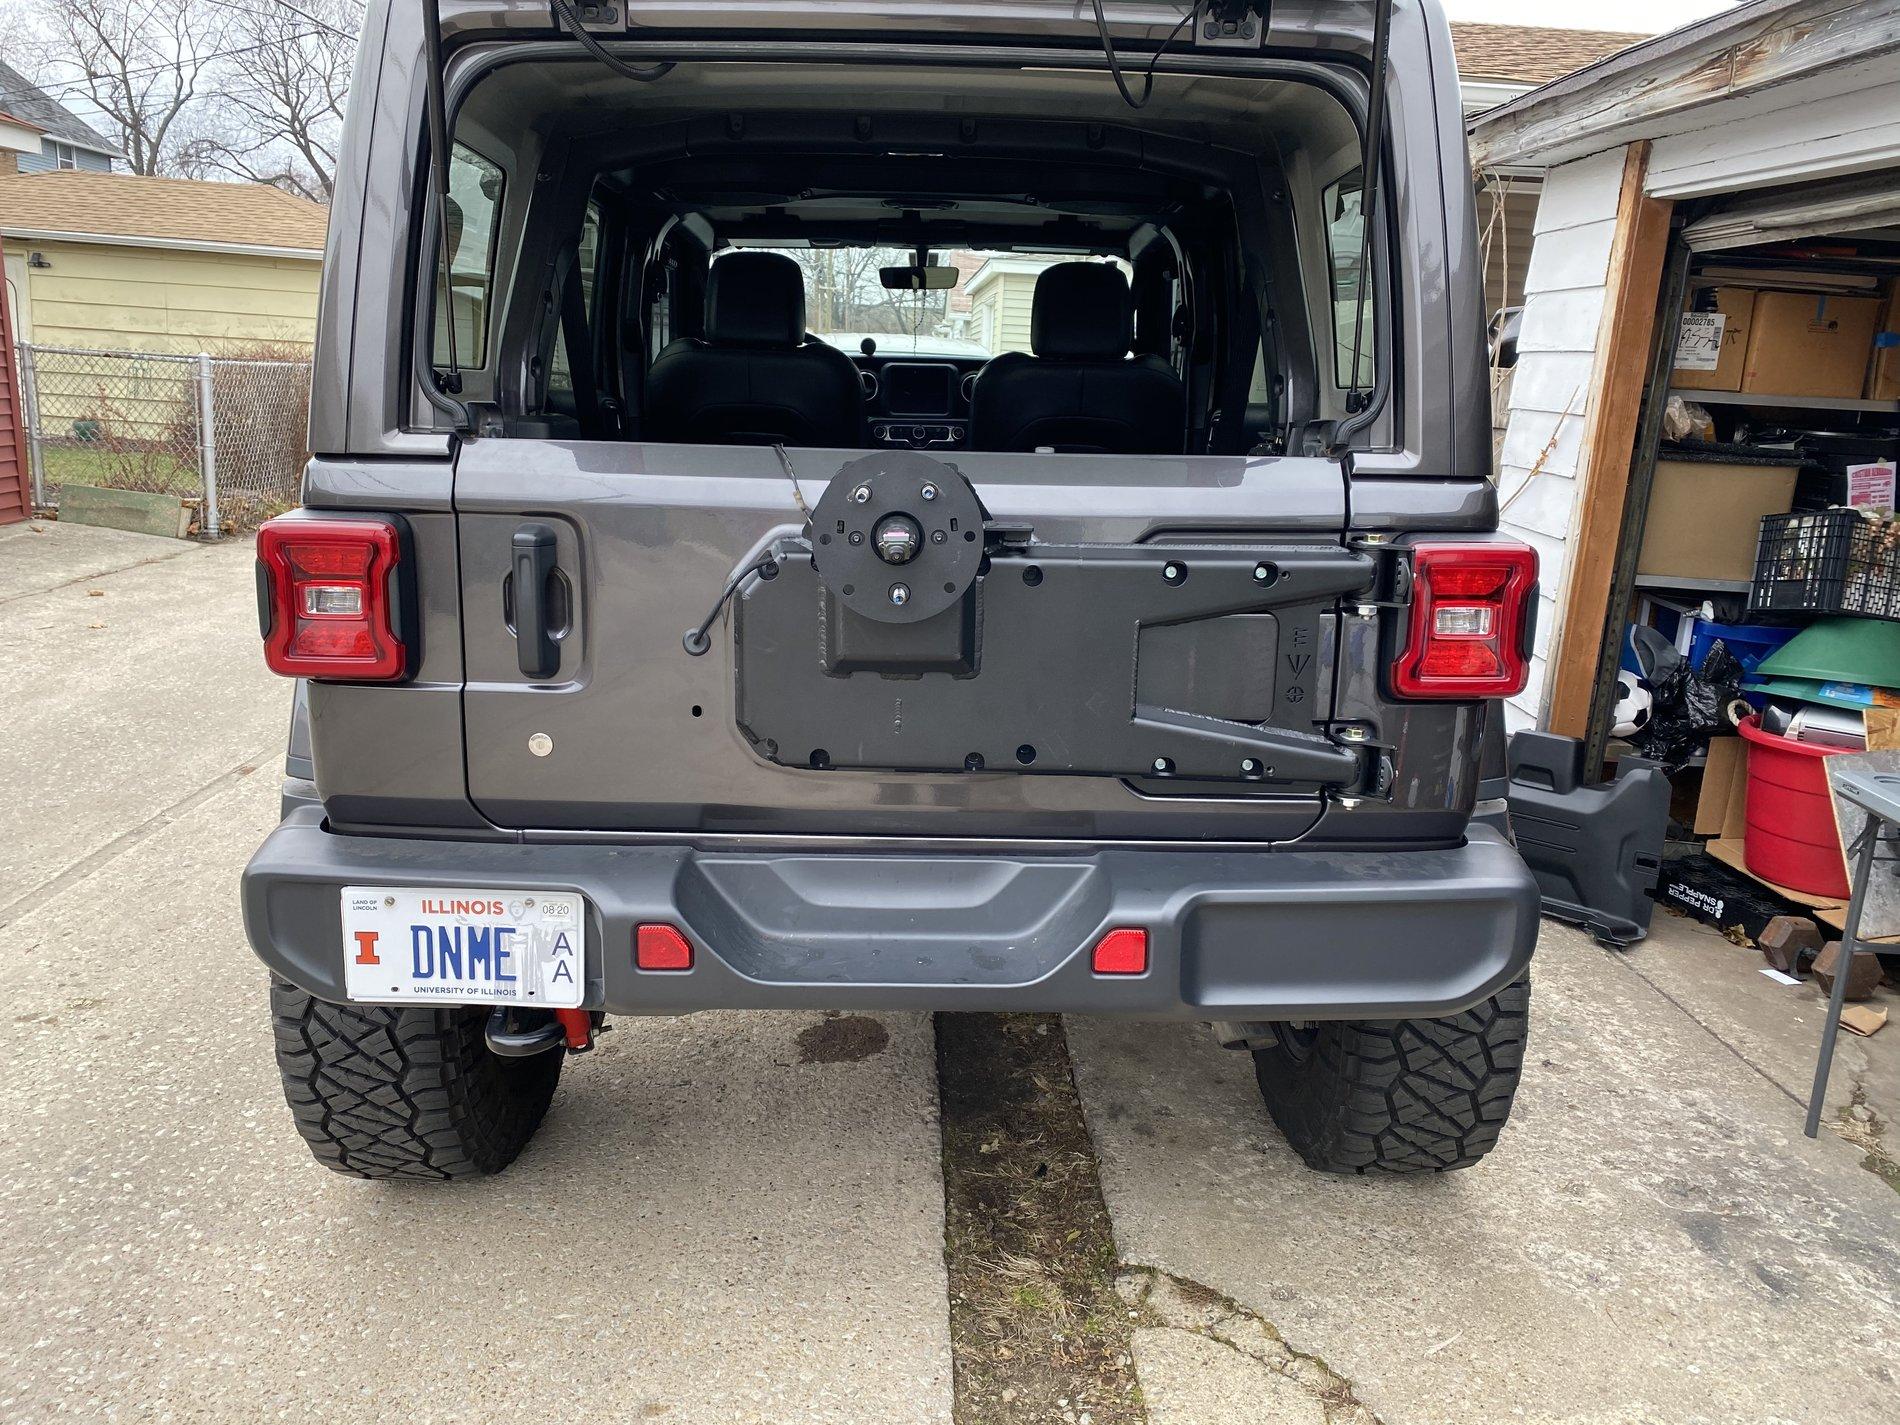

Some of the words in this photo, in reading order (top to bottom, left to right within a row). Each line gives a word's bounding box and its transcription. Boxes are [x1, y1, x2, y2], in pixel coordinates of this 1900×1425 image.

[1668, 887, 1701, 908] PEPPER
[1679, 883, 1716, 906] SNAPPLE
[421, 899, 504, 916] ILLINOIS
[1702, 903, 1715, 914] DR
[410, 925, 517, 982] DNME
[413, 986, 464, 994] UNIVERSITY
[467, 987, 479, 995] OF
[481, 988, 517, 996] ILLINOIS
